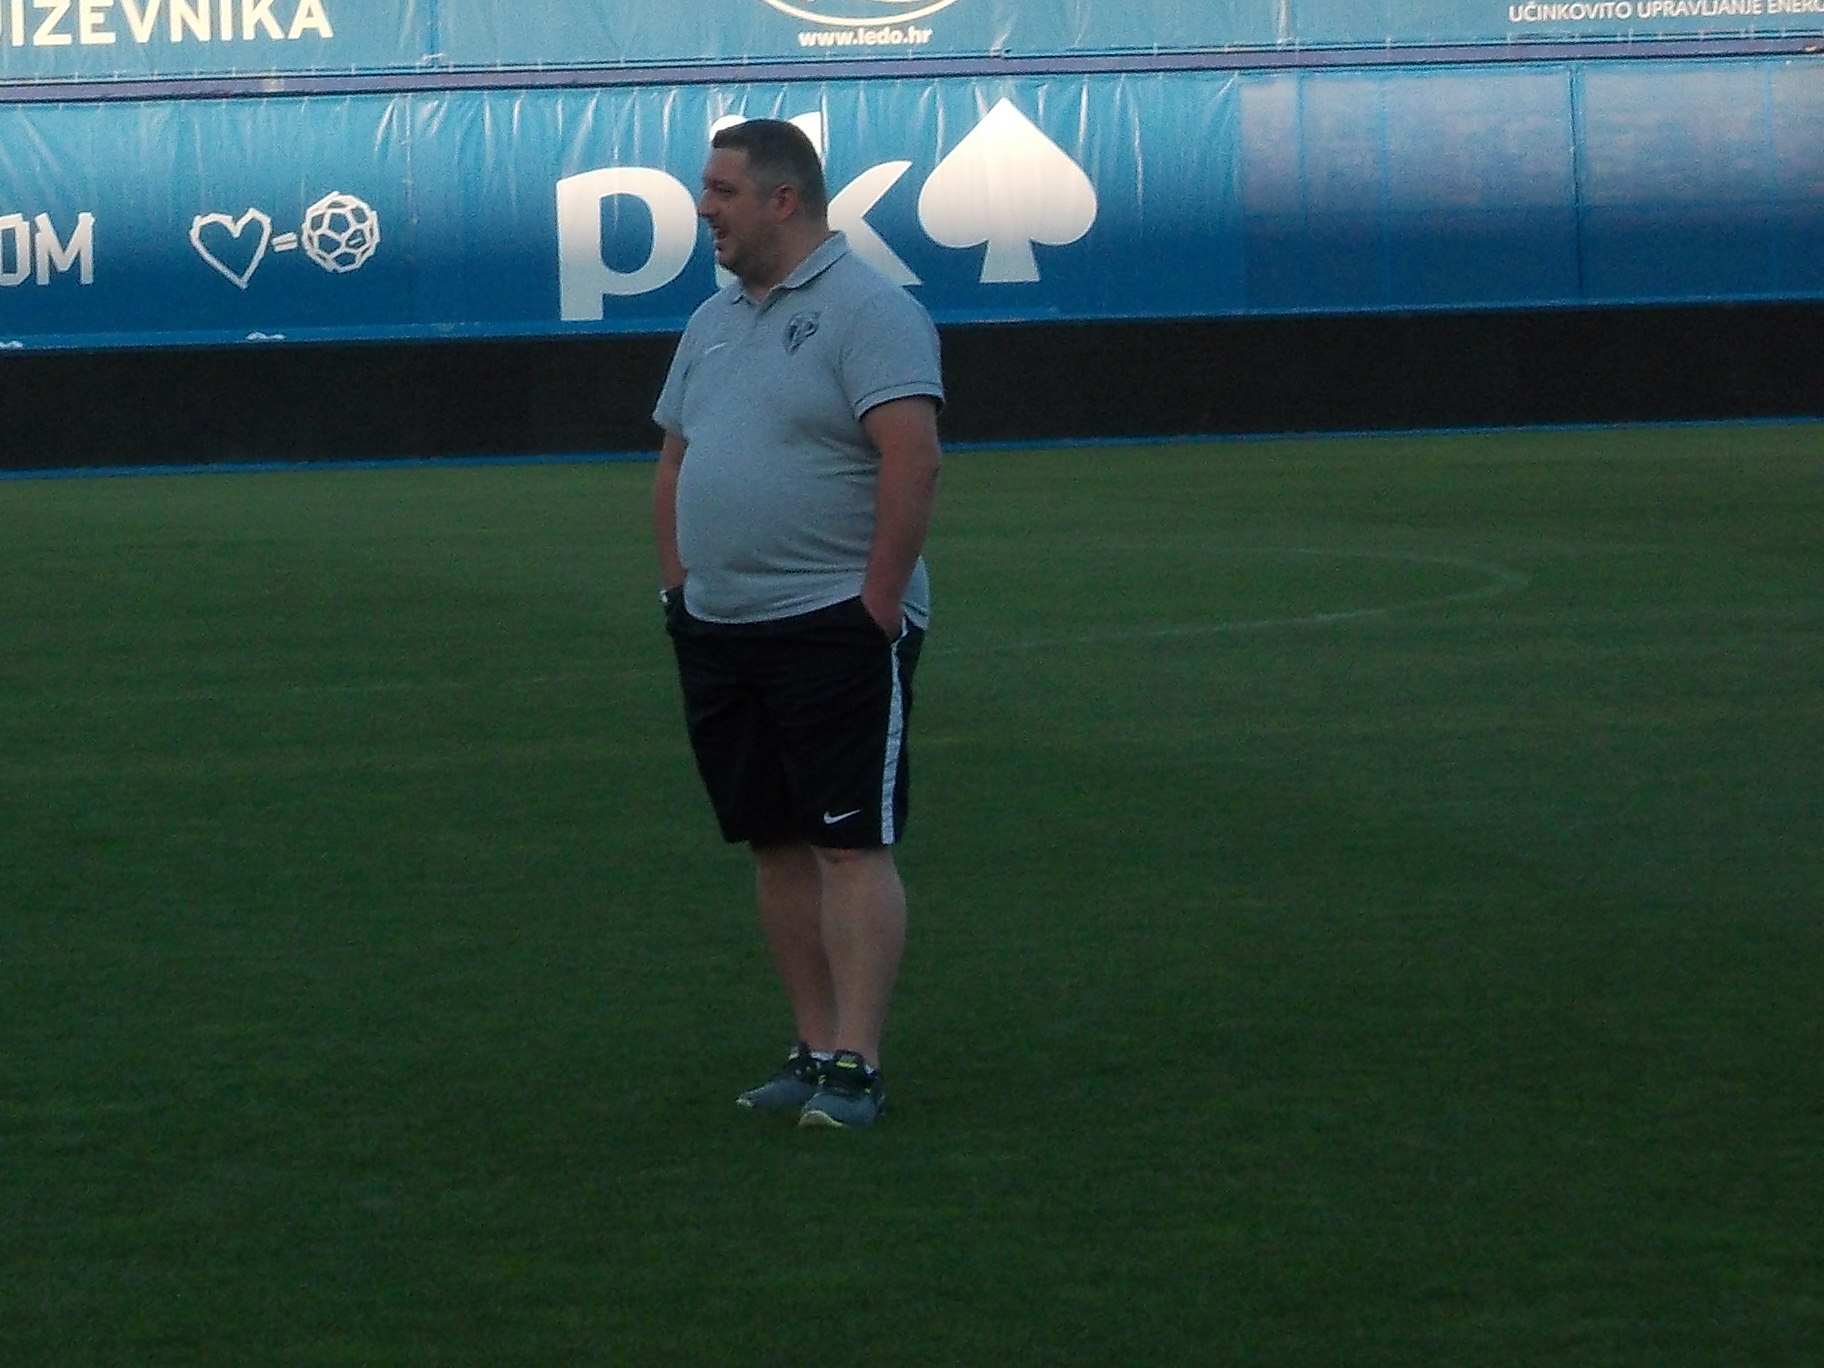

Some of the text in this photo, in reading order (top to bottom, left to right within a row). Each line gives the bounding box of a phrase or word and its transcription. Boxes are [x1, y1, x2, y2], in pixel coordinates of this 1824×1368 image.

[1508, 0, 1633, 23] UČINKOVITO
[797, 25, 934, 48] www.ledo.hr
[556, 111, 922, 321] pk
